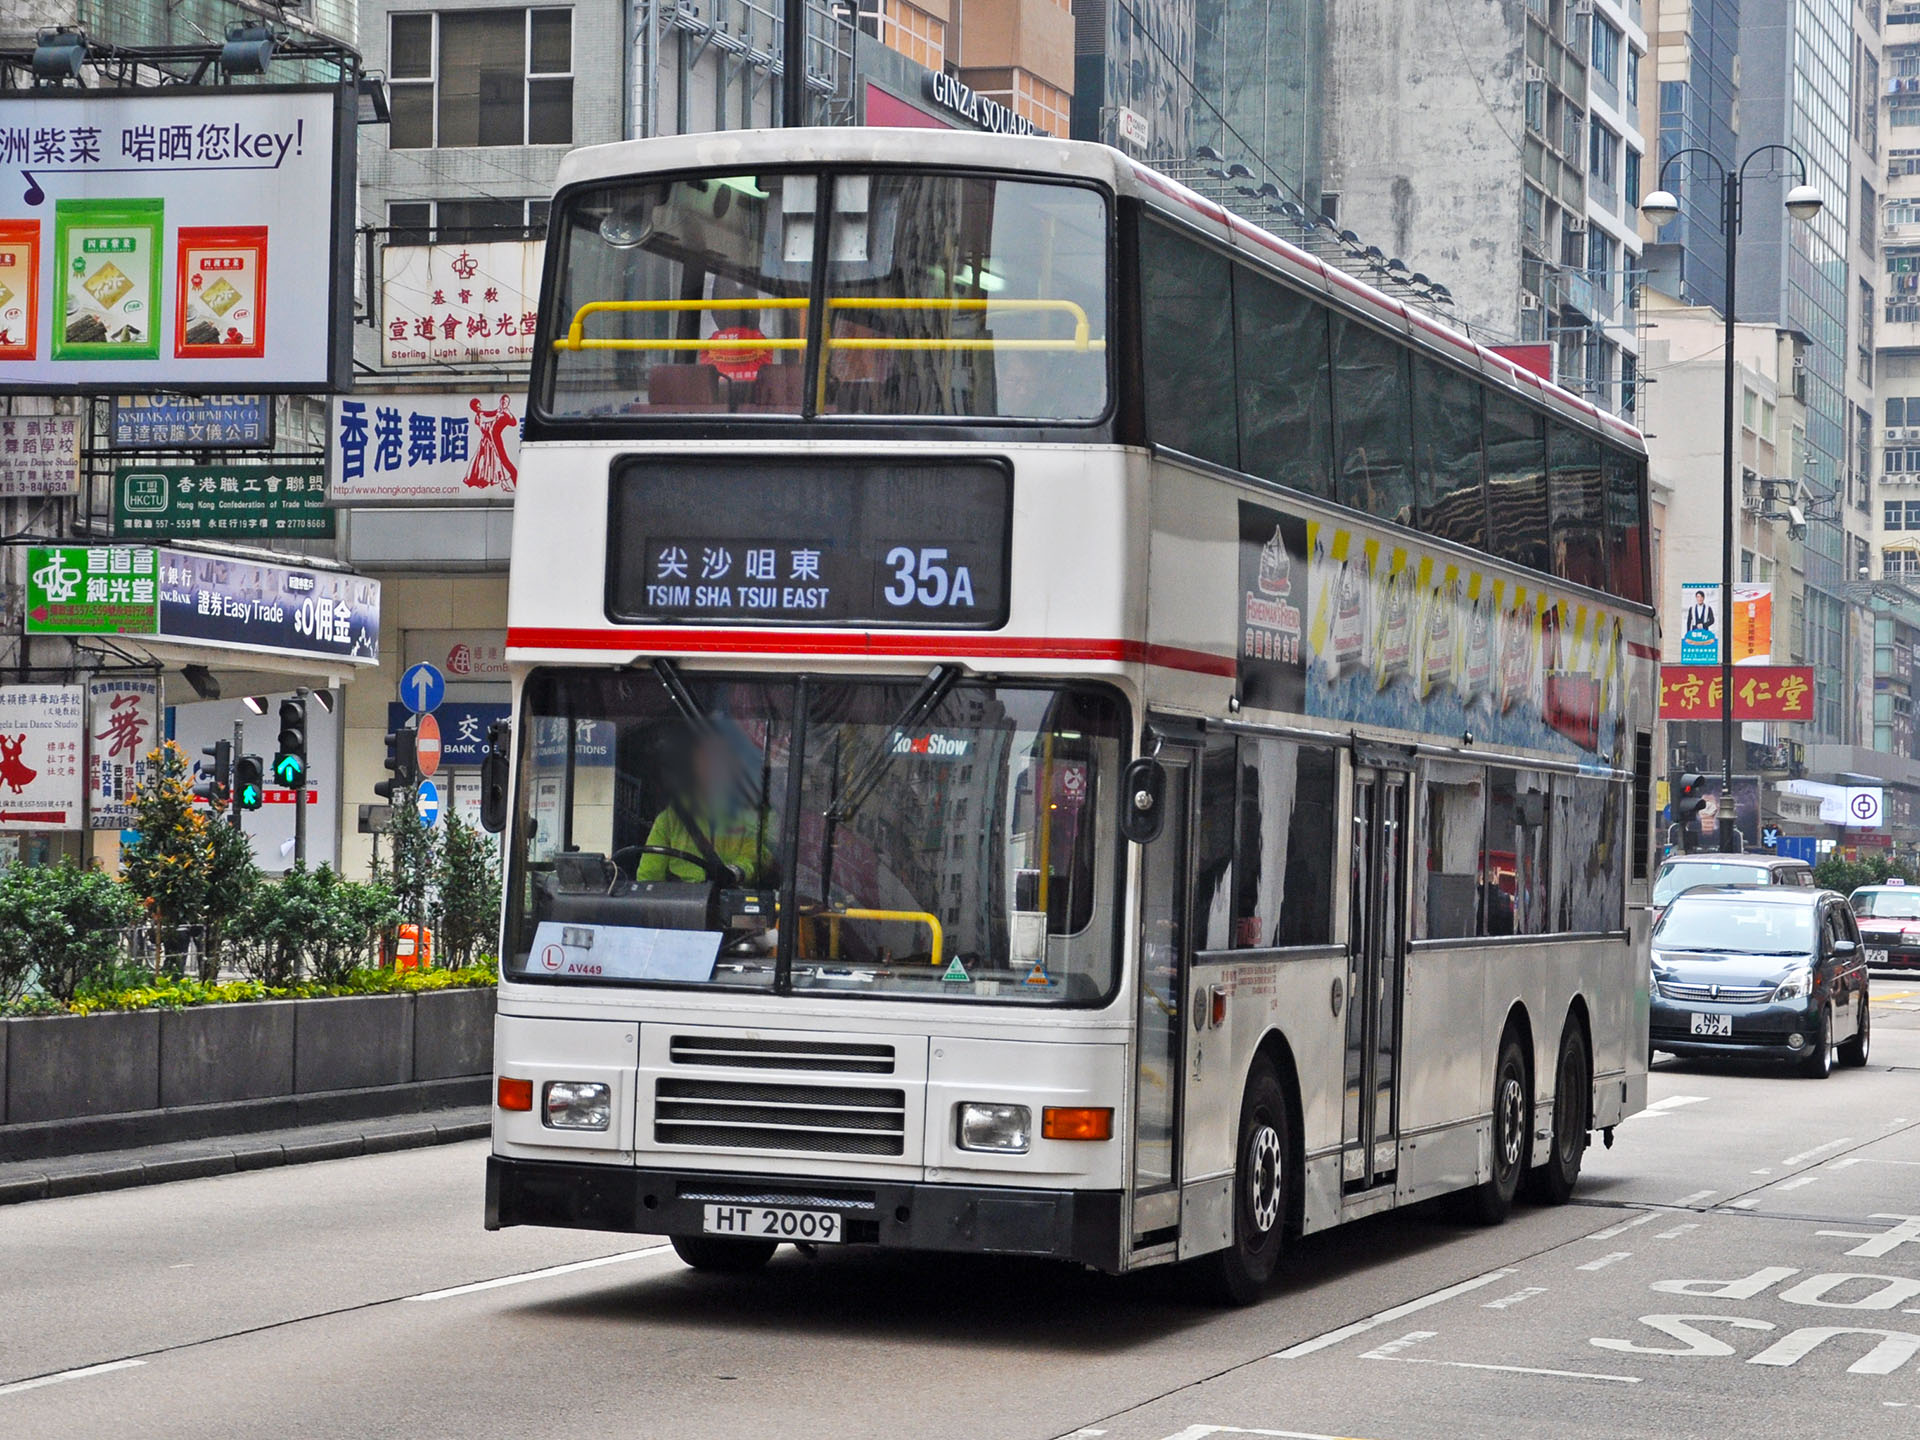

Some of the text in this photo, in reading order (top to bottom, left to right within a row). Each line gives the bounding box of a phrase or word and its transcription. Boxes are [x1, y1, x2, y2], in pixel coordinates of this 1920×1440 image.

[932, 70, 1035, 136] GINZA SQUARE
[0, 126, 103, 164] 洲紫菜
[431, 286, 499, 305] 基督教
[388, 311, 537, 341] 宣道會純光堂
[391, 345, 535, 360] Sterling Light Alliance Churc
[117, 423, 259, 442] 皇達電腦文儀公司
[340, 400, 469, 483] 香港舞蹈
[55, 457, 78, 466] Studio
[136, 481, 158, 493] 工盟
[177, 475, 324, 493] 香港職工會聯盟
[333, 485, 460, 495] http://www.hongkongdance.com
[130, 495, 163, 505] HKCTU
[176, 500, 194, 510] Hong
[199, 500, 215, 510] Kong
[219, 500, 265, 508] Confederation
[270, 500, 277, 508] of
[282, 500, 300, 508] Trade
[87, 549, 153, 573] 宣道會
[657, 547, 821, 581] 尖沙咀東
[884, 547, 975, 607] 35A
[86, 578, 153, 602] 純光堂
[647, 585, 829, 608] TSIM SHA TSUI EAST
[224, 597, 251, 624] Easy
[253, 600, 283, 623] Trade
[15, 720, 28, 729] Lau
[30, 720, 53, 729] Dance
[55, 720, 78, 729] Studio
[444, 744, 475, 754] BANK
[893, 732, 968, 756] RoadShow
[547, 950, 557, 967] L
[568, 964, 602, 974] AV449
[1704, 1013, 1720, 1024] NN
[1695, 1024, 1729, 1035] 6724
[717, 1207, 835, 1237] HT 2009
